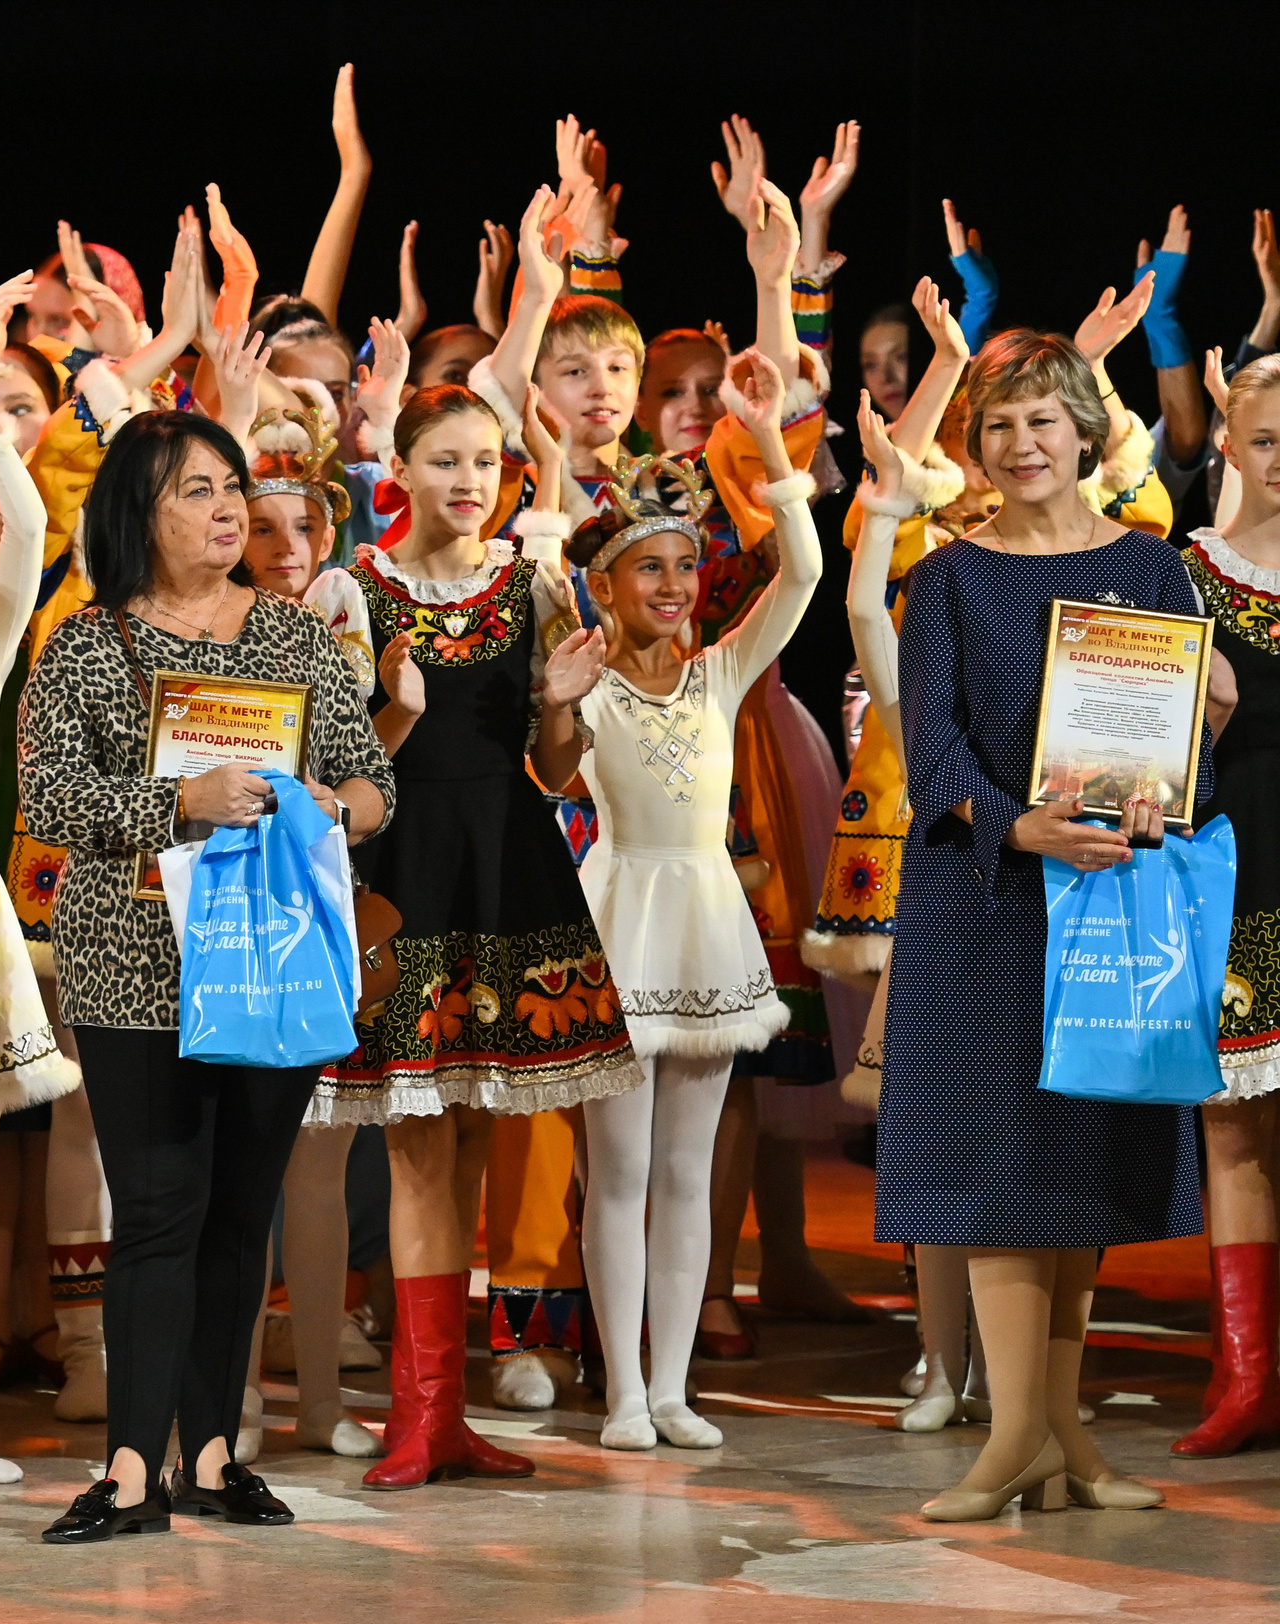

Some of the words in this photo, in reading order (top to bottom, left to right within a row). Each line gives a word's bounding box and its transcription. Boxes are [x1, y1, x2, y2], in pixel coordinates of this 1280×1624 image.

[1088, 626, 1115, 636] ШАГ
[1119, 630, 1127, 638] К
[1131, 631, 1173, 644] МЕЧТЕ
[1106, 638, 1170, 656] Владимире
[1069, 651, 1184, 674] БЛАГОДАРНОСТЬ
[190, 702, 216, 712] ШАГ
[220, 705, 228, 714] К
[231, 706, 272, 719] МЕЧТЕ
[172, 730, 283, 751] БЛАГОДАРНОСТЬ
[252, 919, 288, 935] мчте
[1065, 917, 1132, 926] ФЕСТИВАЛЬНОЕ
[1063, 928, 1111, 938] ДВИЖЕНИЕ
[215, 935, 255, 950] лет
[1061, 948, 1098, 966] Шаг
[1101, 953, 1111, 965] к
[1115, 955, 1163, 967] мечте
[1076, 968, 1119, 983] лет
[194, 979, 323, 995] WWW.DREAM-EST.RU
